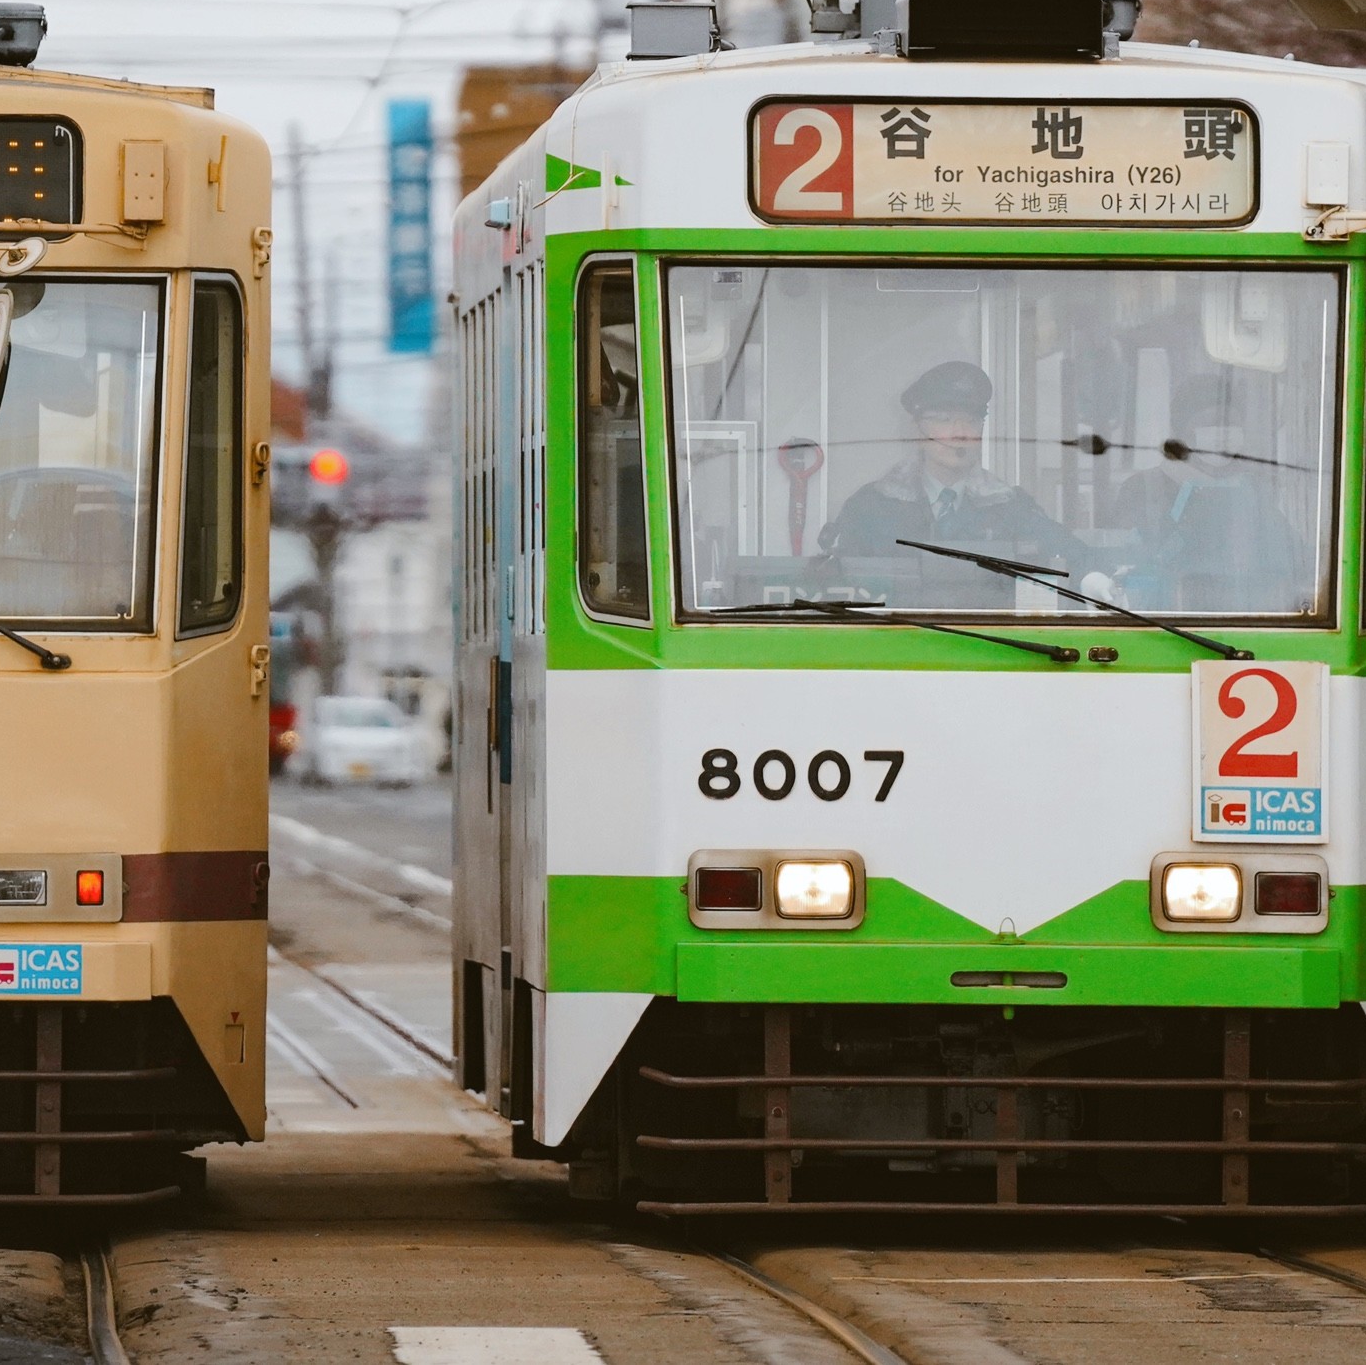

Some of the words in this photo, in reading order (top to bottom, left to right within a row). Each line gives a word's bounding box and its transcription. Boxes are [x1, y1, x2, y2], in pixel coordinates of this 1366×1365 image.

[880, 107, 1236, 160] 谷地頭
[773, 108, 843, 211] 2
[935, 166, 964, 183] for
[977, 166, 1115, 187] Yachigashira
[1128, 164, 1182, 186] (Y26)
[888, 191, 962, 213] 谷地头
[995, 192, 1069, 214] 谷地頭
[1101, 192, 1229, 214] 야치가시라
[1218, 669, 1298, 778] 2
[697, 748, 906, 803] 8007
[1255, 790, 1316, 813] ICAS
[1255, 815, 1315, 832] nimoca
[21, 949, 80, 972] ICAS
[21, 974, 79, 990] nimoca
